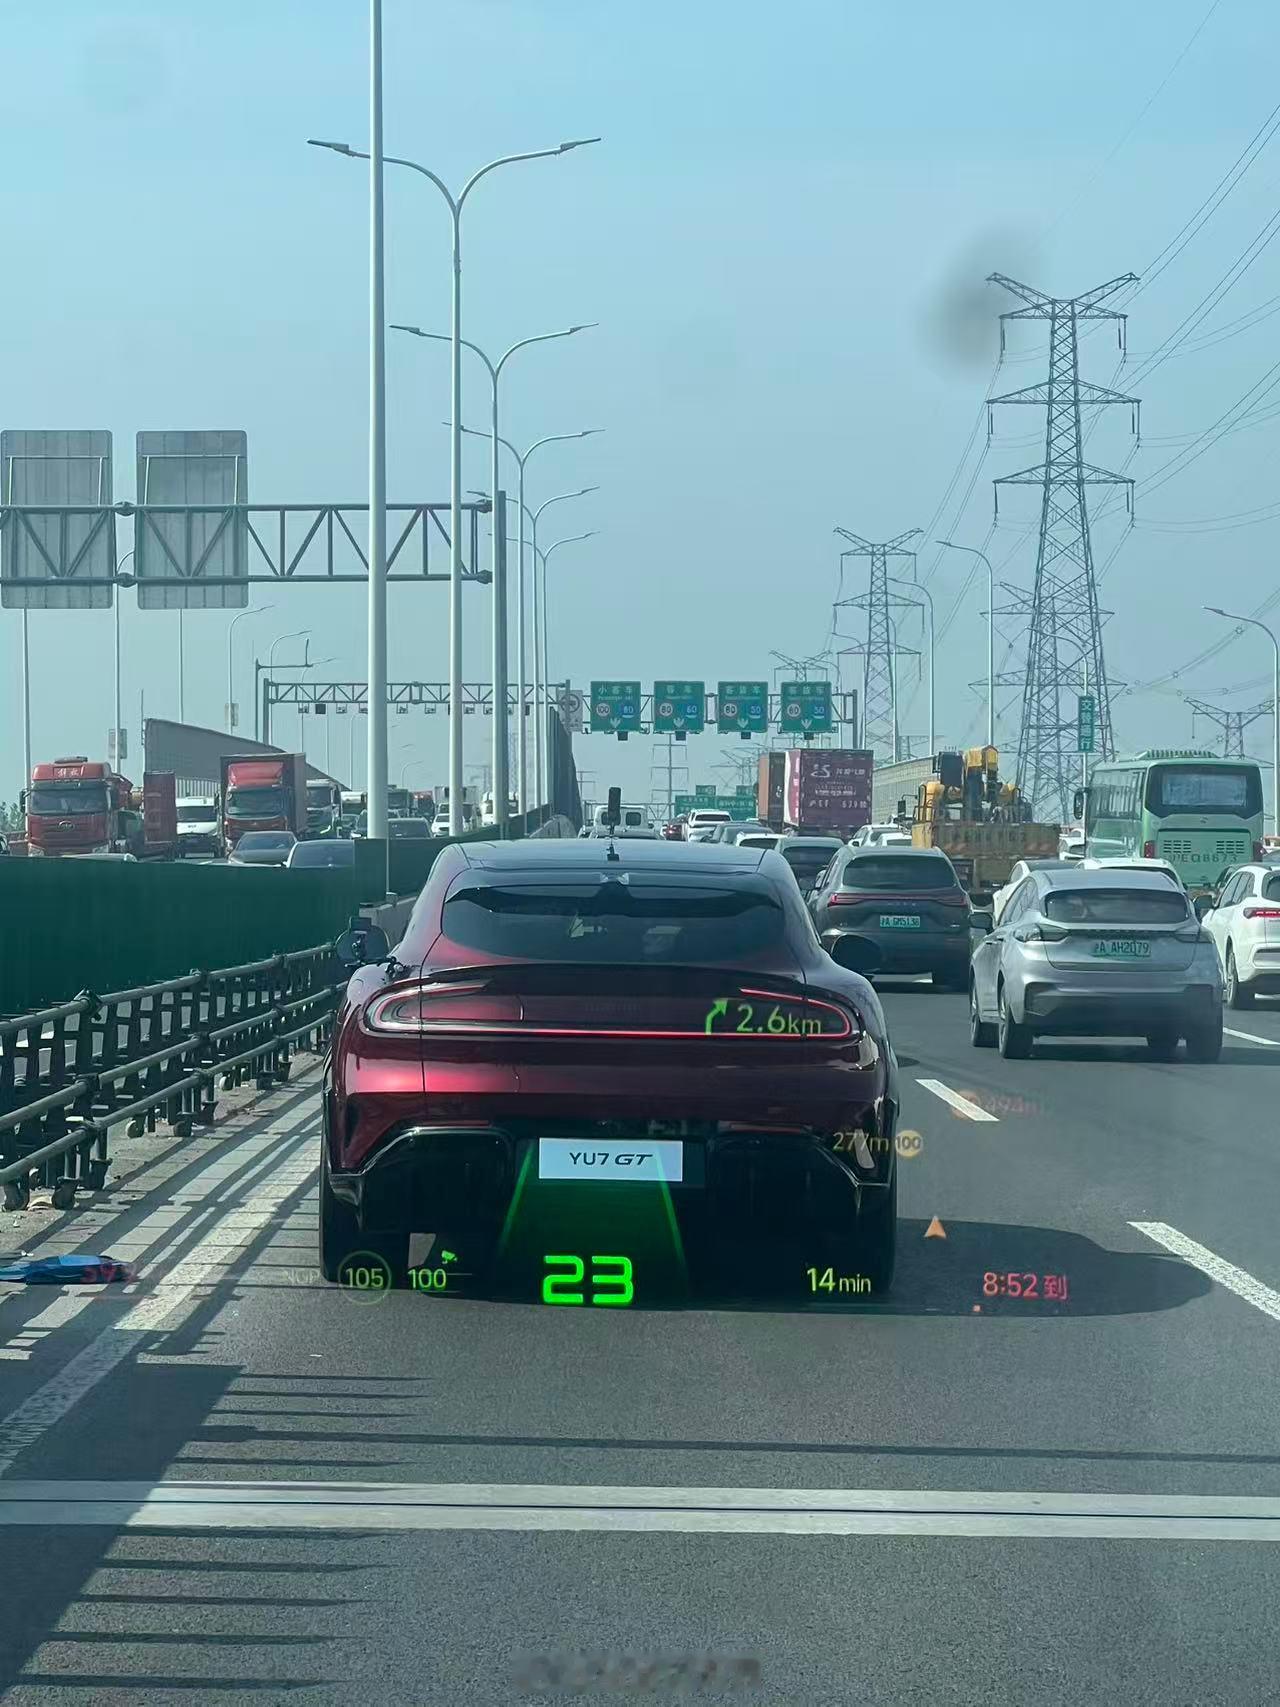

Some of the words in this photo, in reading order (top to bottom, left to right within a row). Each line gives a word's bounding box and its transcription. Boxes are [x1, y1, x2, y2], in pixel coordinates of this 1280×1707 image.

[598, 705, 610, 714] 100
[1111, 941, 1150, 954] AH2079
[737, 1003, 822, 1036] 2.6km
[896, 1135, 920, 1151] 100
[569, 1152, 610, 1166] YU7
[614, 1153, 653, 1166] GT
[345, 1267, 384, 1289] 105
[407, 1268, 447, 1290] 100
[542, 1255, 634, 1305] 23
[806, 1267, 836, 1293] 14
[838, 1273, 872, 1294] min
[982, 1272, 1039, 1299] 8:52
[1043, 1274, 1069, 1300] 到
